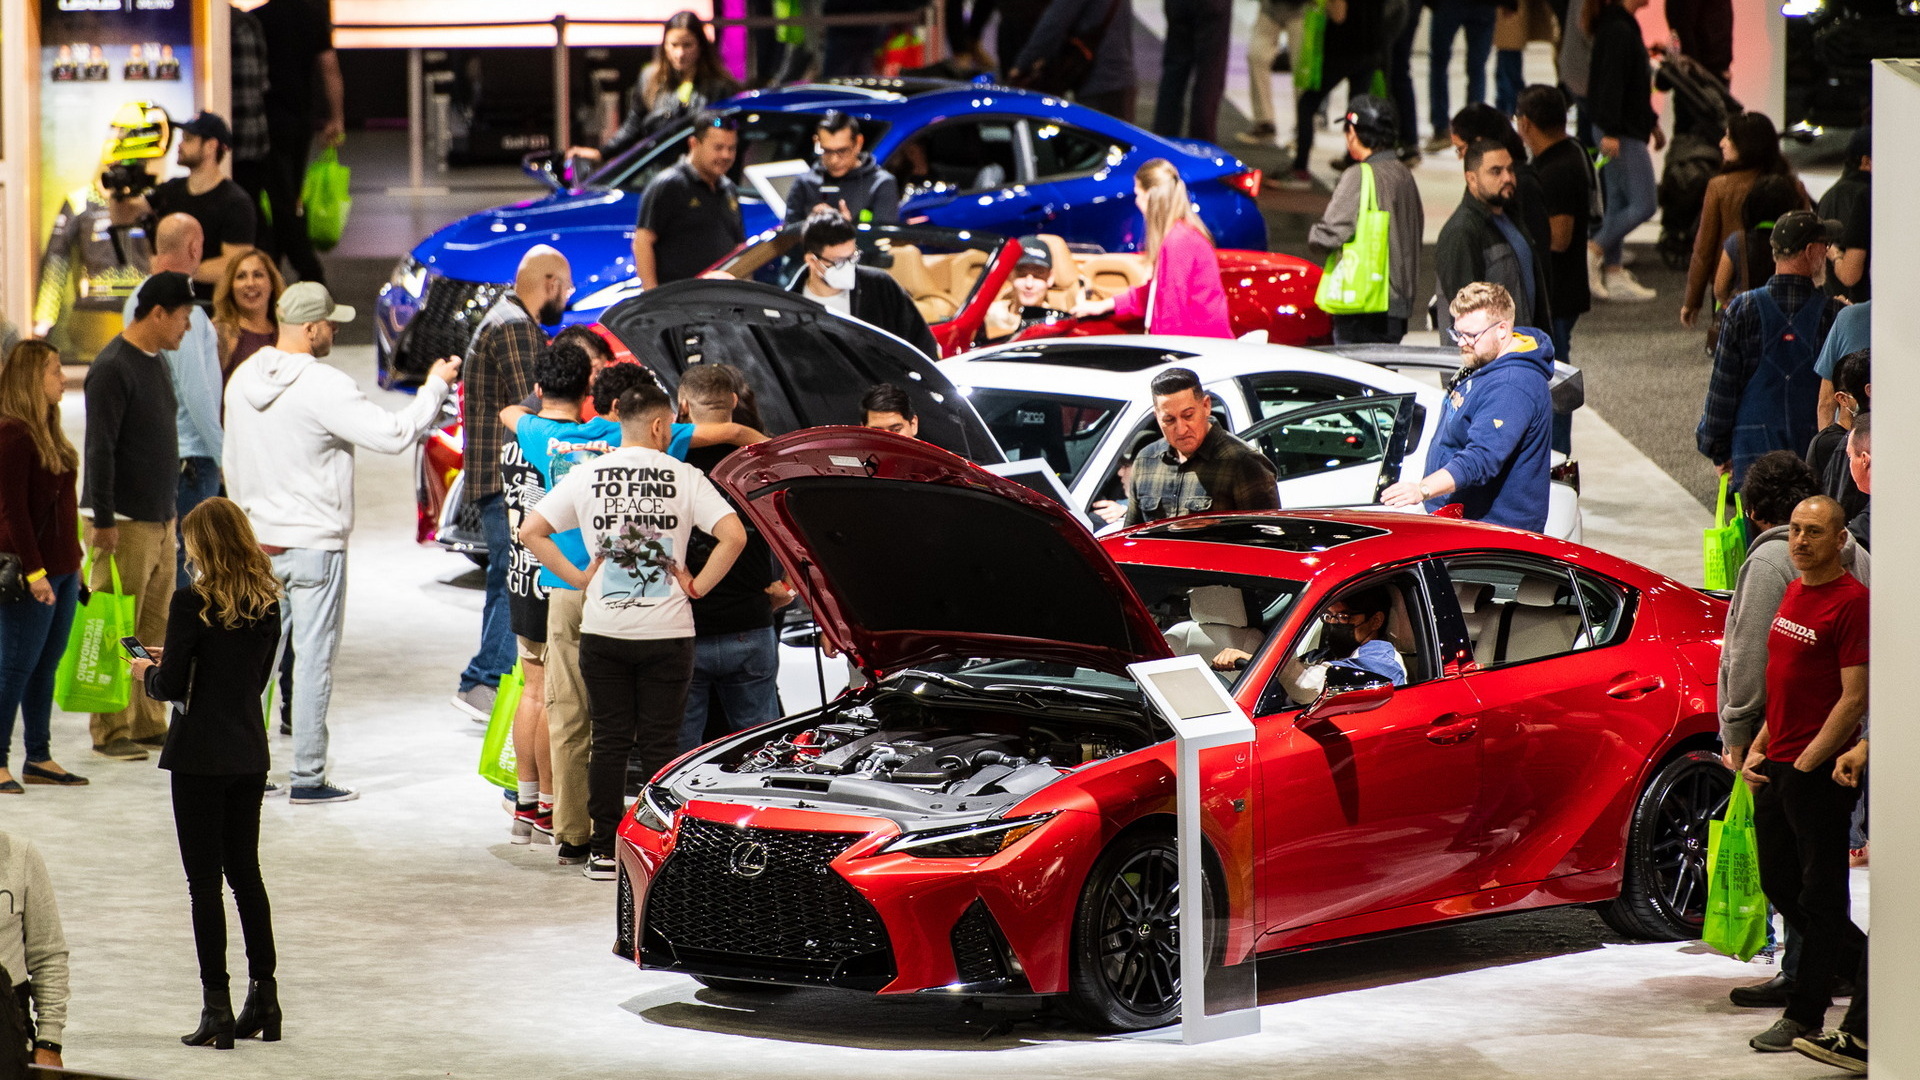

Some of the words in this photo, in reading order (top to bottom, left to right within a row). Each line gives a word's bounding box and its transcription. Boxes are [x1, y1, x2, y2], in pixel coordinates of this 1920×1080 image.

[594, 467, 675, 483] TRYING
[591, 482, 622, 498] TO
[628, 482, 677, 498] FIND
[604, 498, 666, 514] PEACE
[593, 515, 618, 530] OF
[624, 515, 679, 530] MIND
[1776, 616, 1817, 641] HONDA
[76, 618, 96, 681] VECINDARIO
[86, 669, 97, 683] TU
